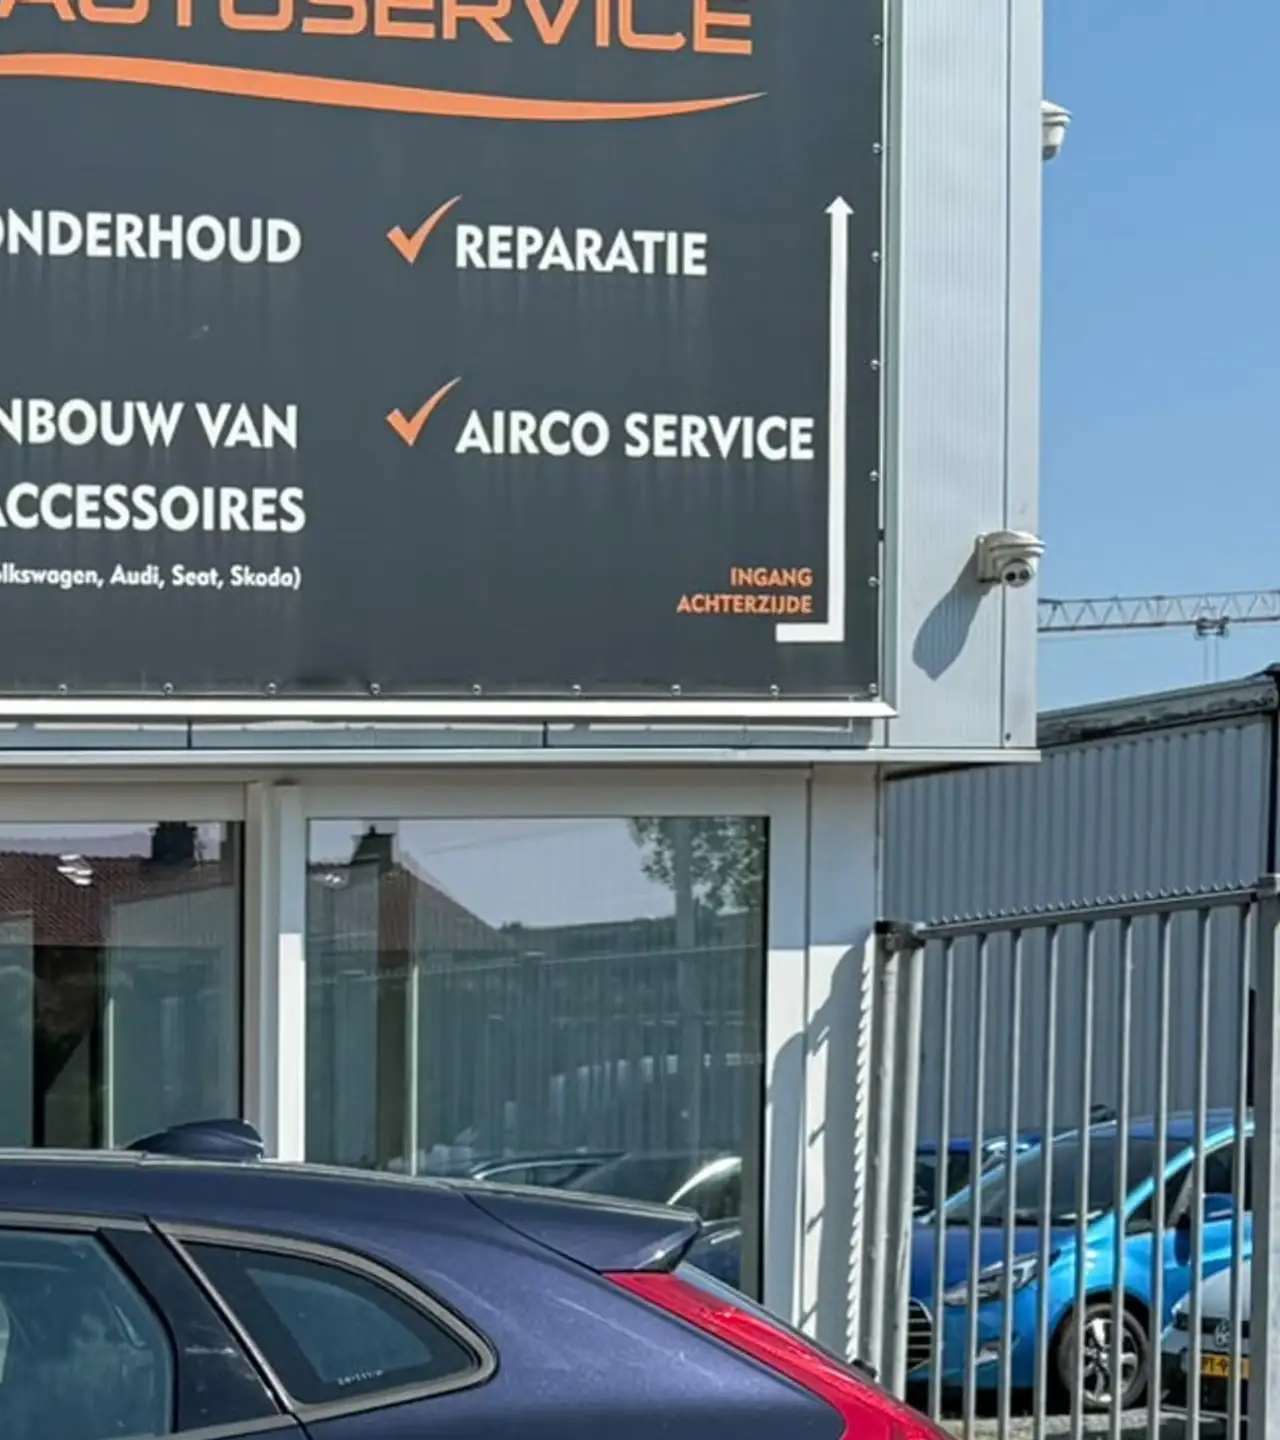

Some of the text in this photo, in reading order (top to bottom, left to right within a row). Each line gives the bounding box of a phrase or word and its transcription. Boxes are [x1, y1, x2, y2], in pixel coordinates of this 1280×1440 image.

[455, 224, 708, 277] REPARATIE
[196, 402, 299, 450] VAN
[453, 409, 815, 462] AIRCO SERVICE
[109, 563, 165, 590] Audi,
[171, 563, 225, 590] Seat,
[229, 564, 303, 590] Skoda)
[730, 567, 813, 588] INGANG
[676, 593, 813, 614] ACHTERZIJDE
